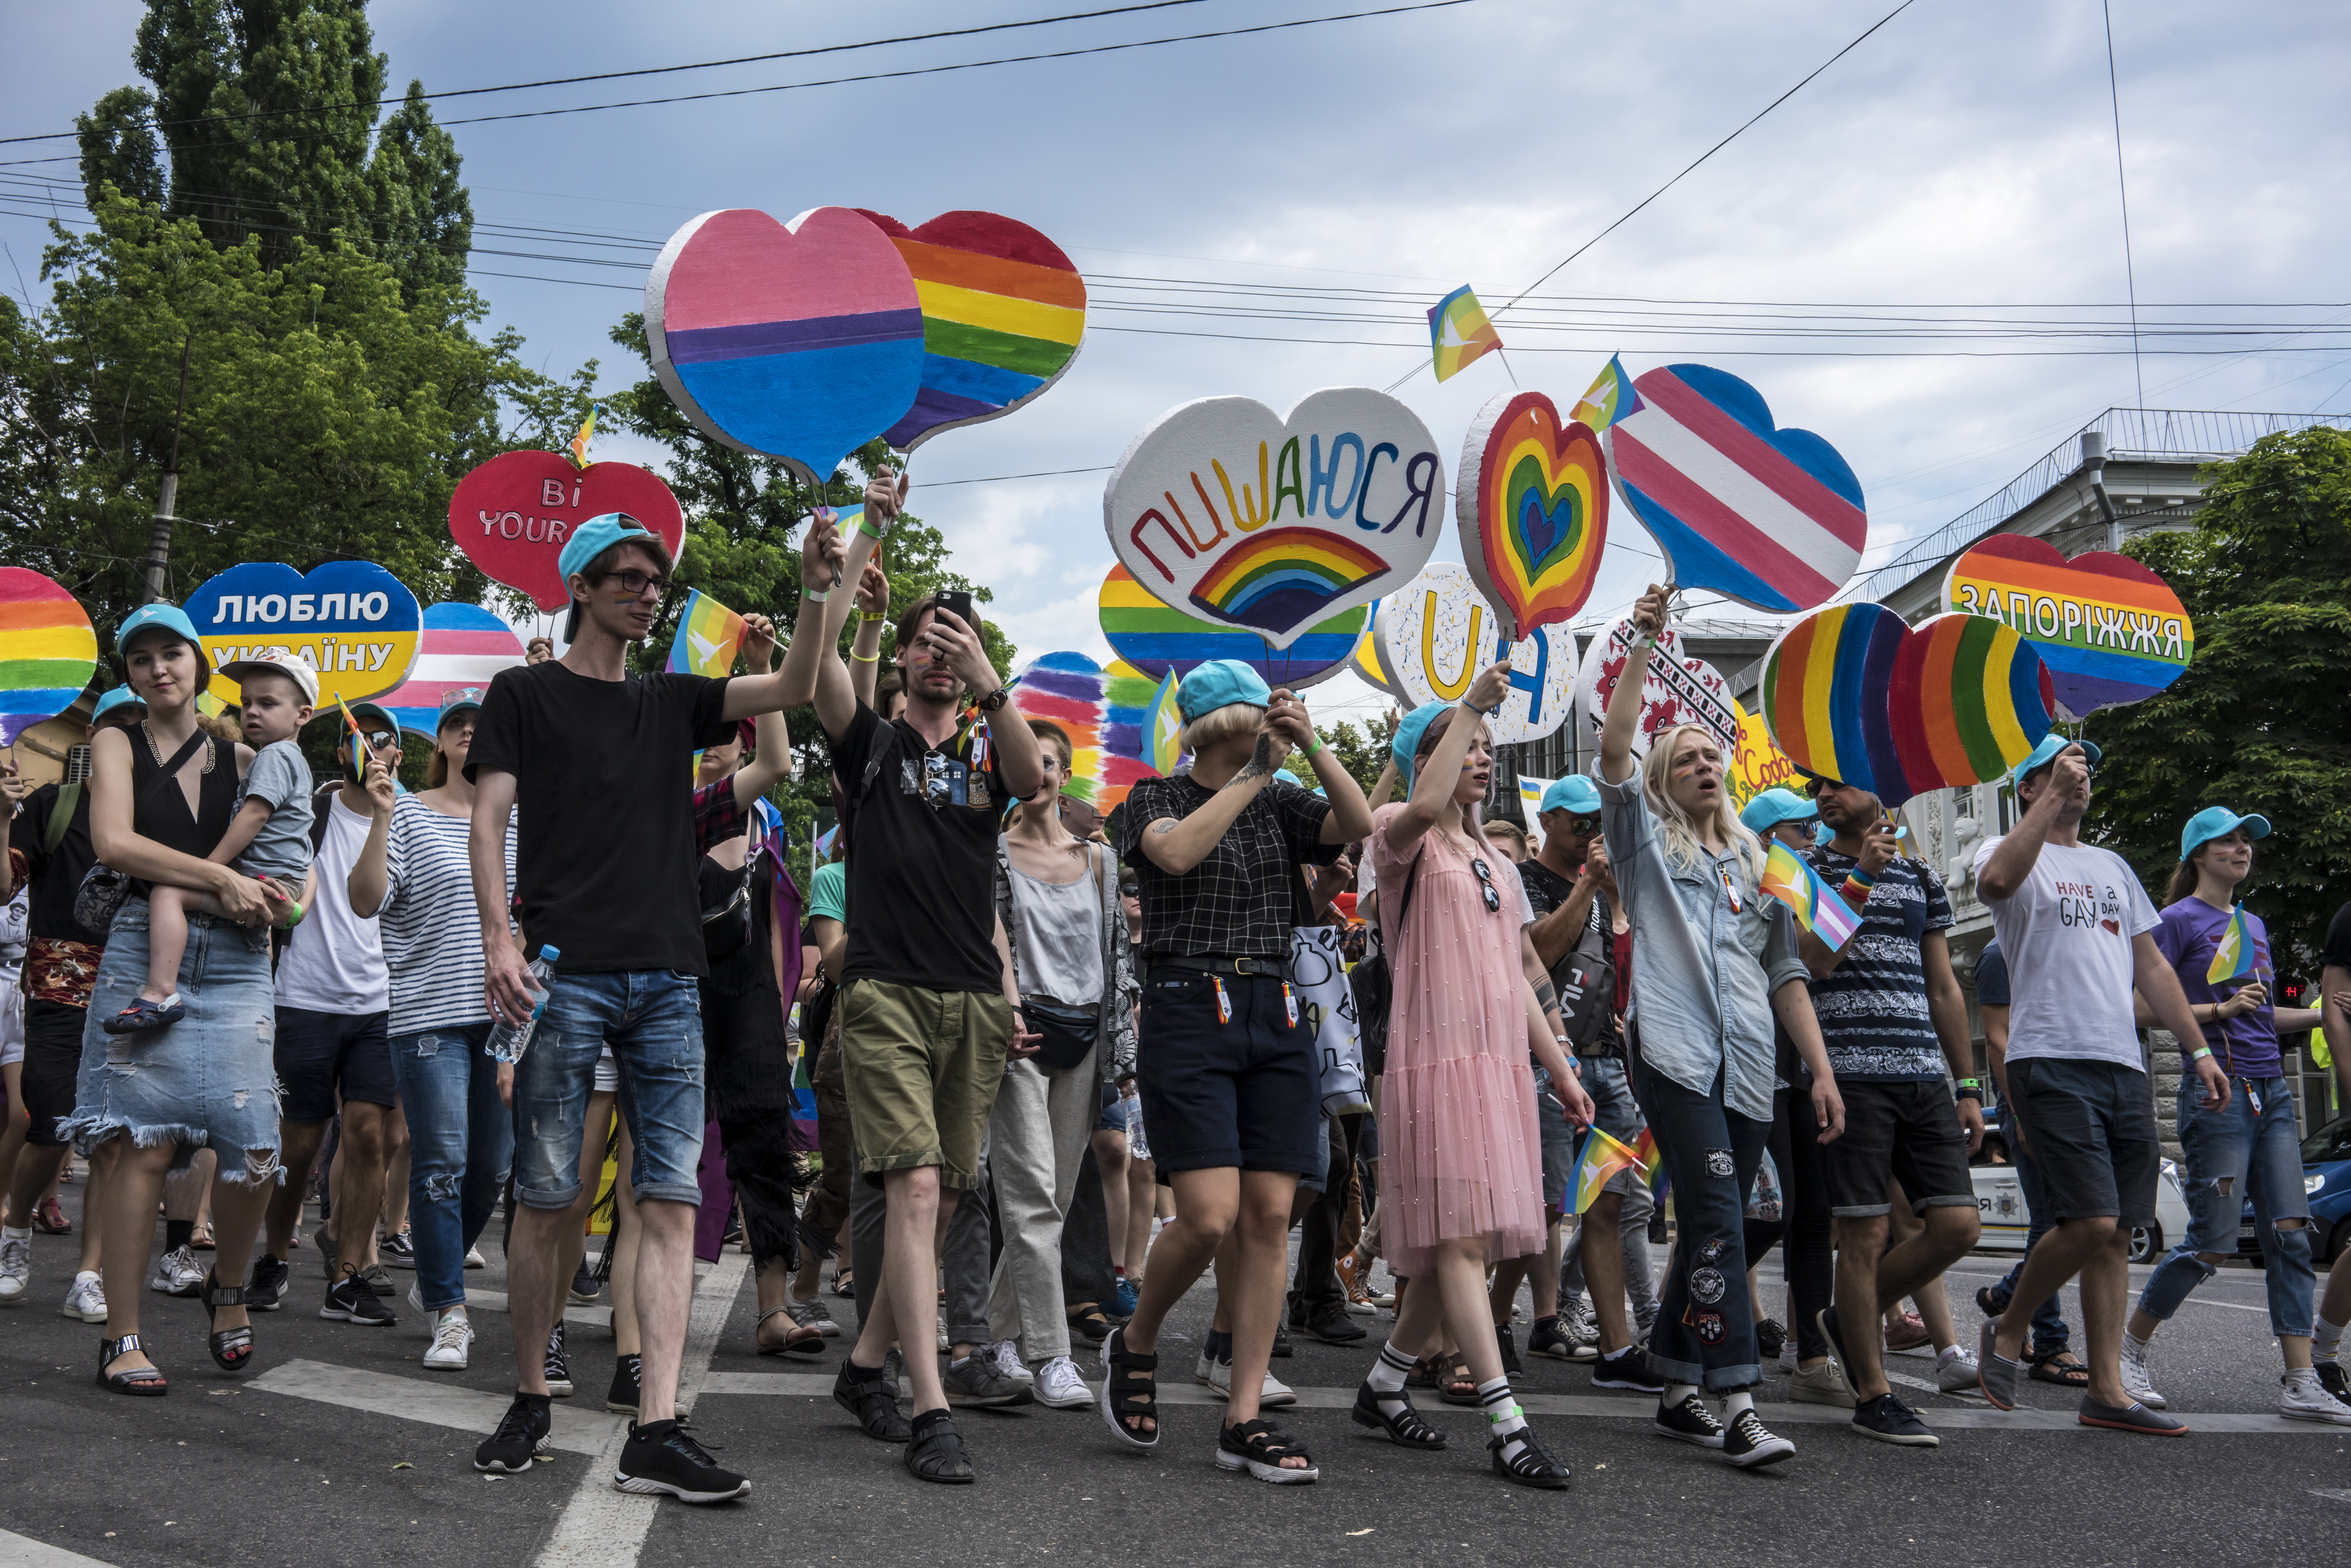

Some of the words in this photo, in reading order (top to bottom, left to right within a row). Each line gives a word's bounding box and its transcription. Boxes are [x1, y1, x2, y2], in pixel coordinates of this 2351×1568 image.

[541, 477, 582, 508] Bi
[212, 591, 389, 624] ЛЮБЛЮ
[1960, 584, 2185, 660] ЗАПОРІЖЖЯ
[212, 638, 395, 675] УКАЇНУ
[2055, 882, 2094, 899] HAVE
[2106, 886, 2118, 900] a
[2060, 897, 2097, 929] GAY
[2101, 902, 2119, 915] DAY
[1559, 968, 1589, 1018] FILA
[2286, 986, 2296, 997] 14
[1694, 1269, 1718, 1278] RAMONES
[1699, 1314, 1720, 1324] KISS
